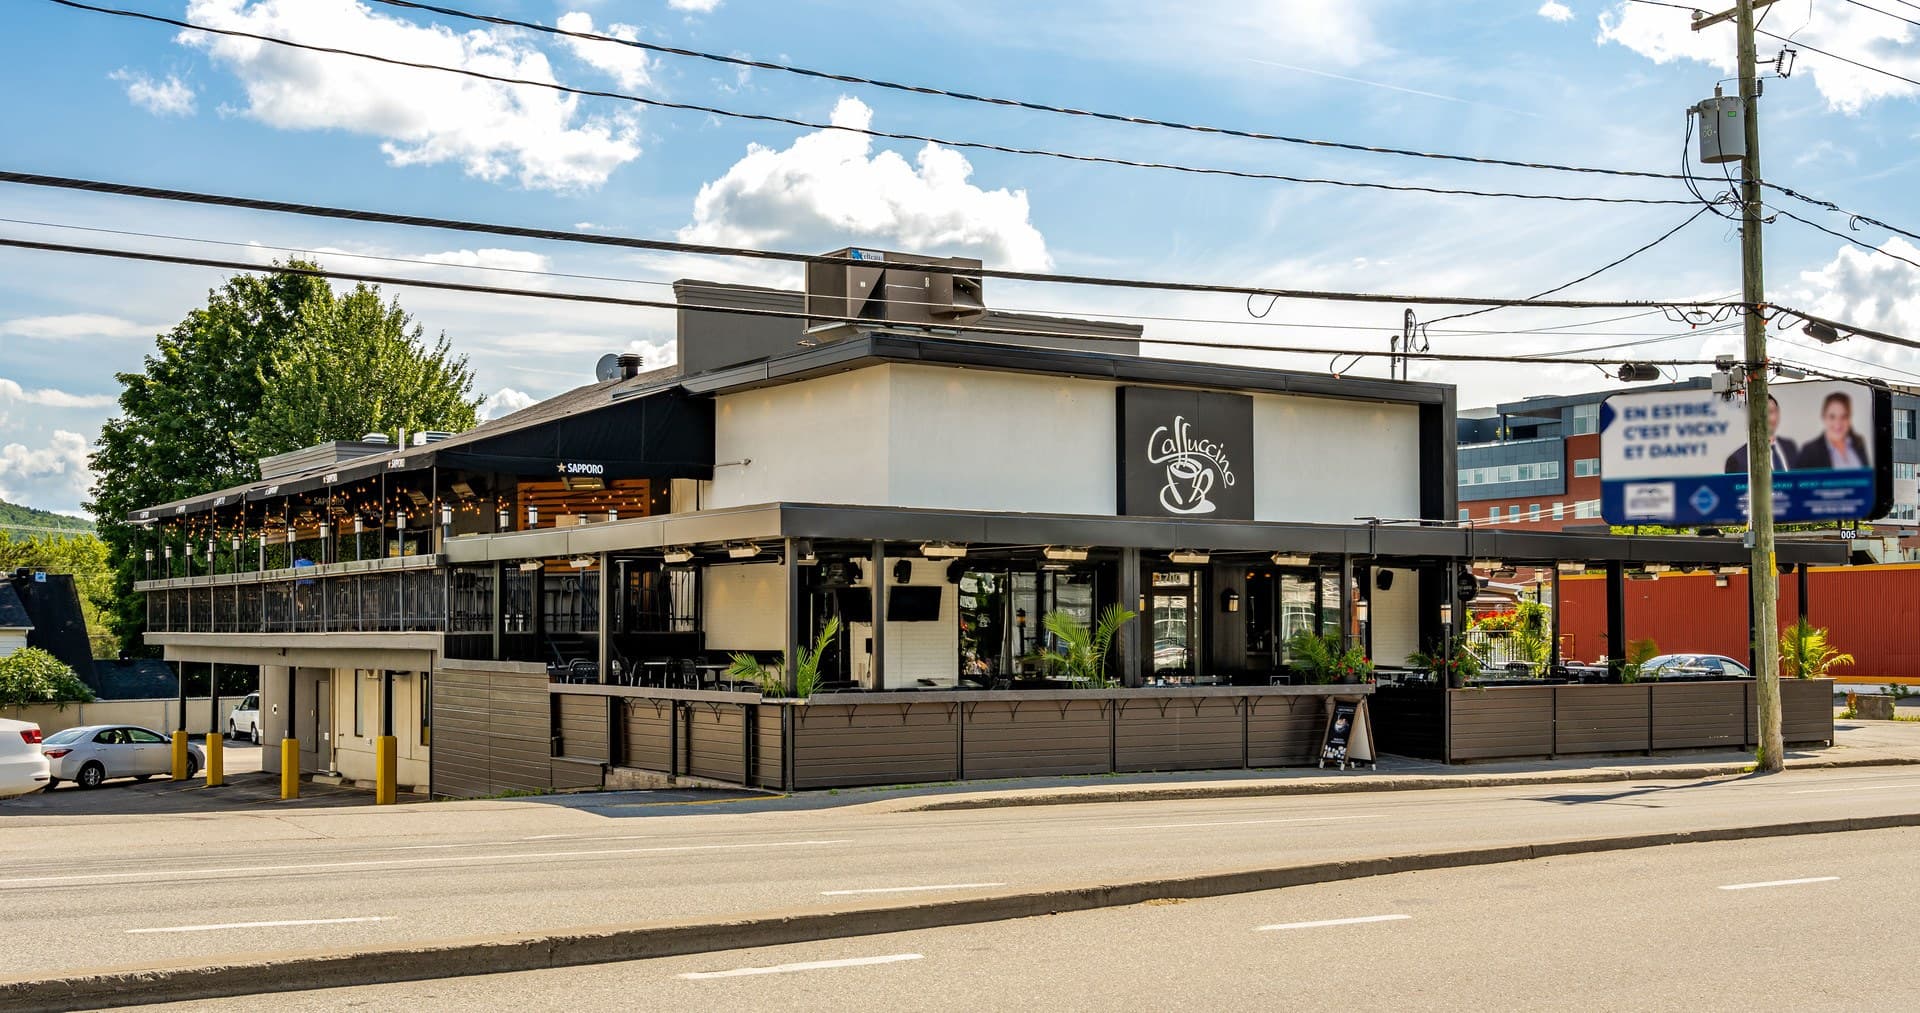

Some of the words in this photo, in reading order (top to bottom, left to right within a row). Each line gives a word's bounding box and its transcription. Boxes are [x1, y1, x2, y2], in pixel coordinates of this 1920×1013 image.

[1624, 407, 1647, 420] EN
[1676, 422, 1729, 437] VICKY
[1147, 415, 1235, 487] Caffuccino
[1624, 445, 1644, 459] ET
[567, 463, 604, 474] SAPPORO
[1841, 530, 1856, 539] 005
